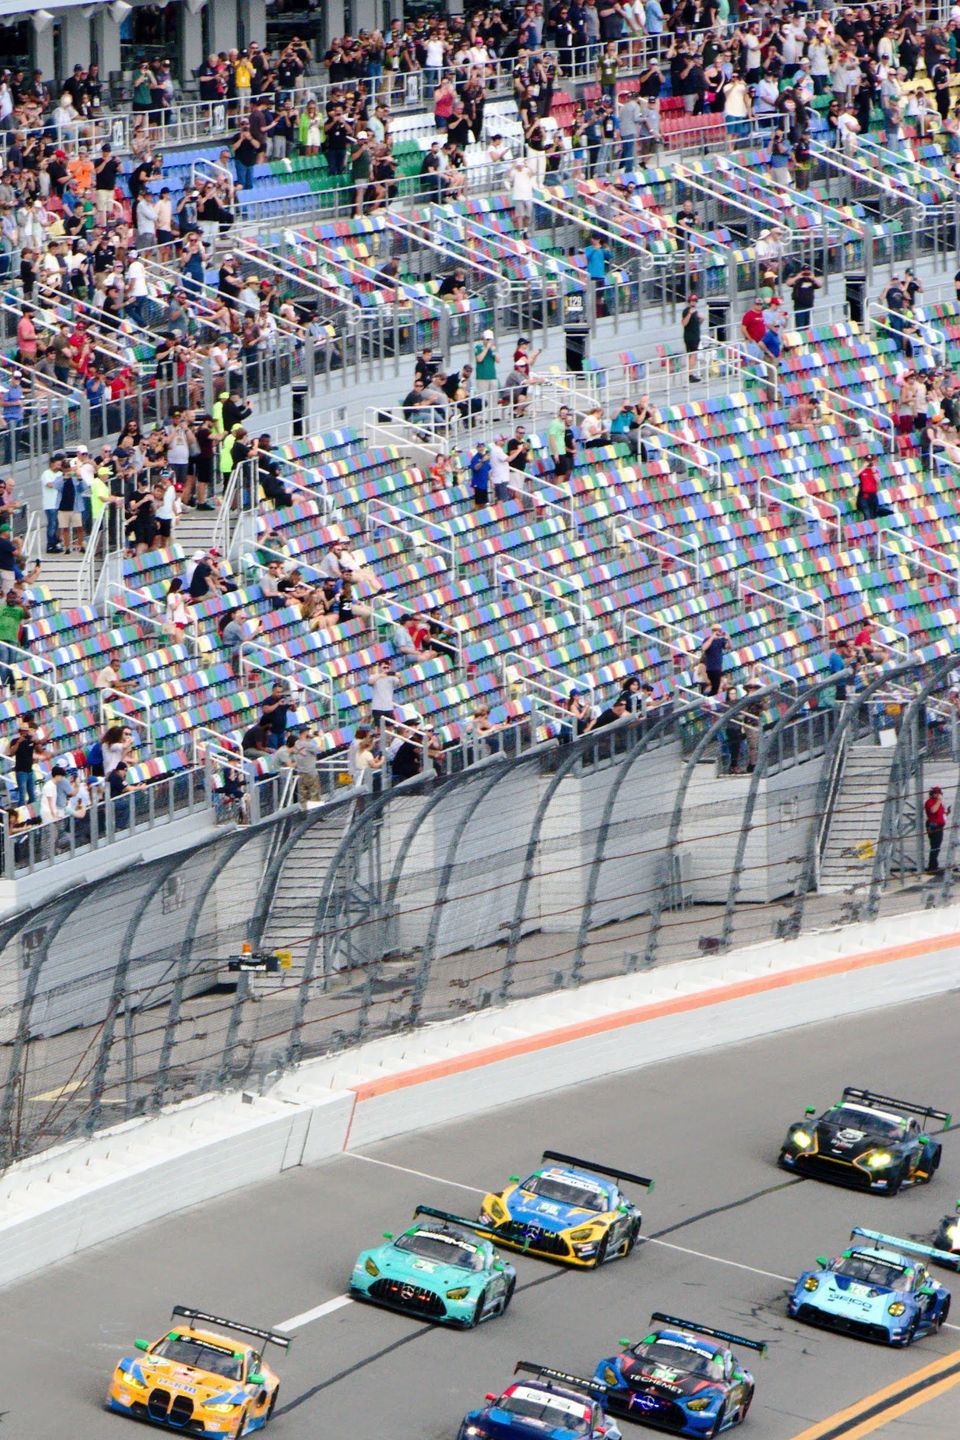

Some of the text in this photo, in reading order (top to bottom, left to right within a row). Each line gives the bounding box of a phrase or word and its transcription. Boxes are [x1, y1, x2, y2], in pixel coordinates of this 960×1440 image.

[570, 296, 582, 306] 129
[829, 1293, 872, 1309] GEICO
[547, 1370, 607, 1391] MUSTANG
[630, 1374, 684, 1394] TECHEMET
